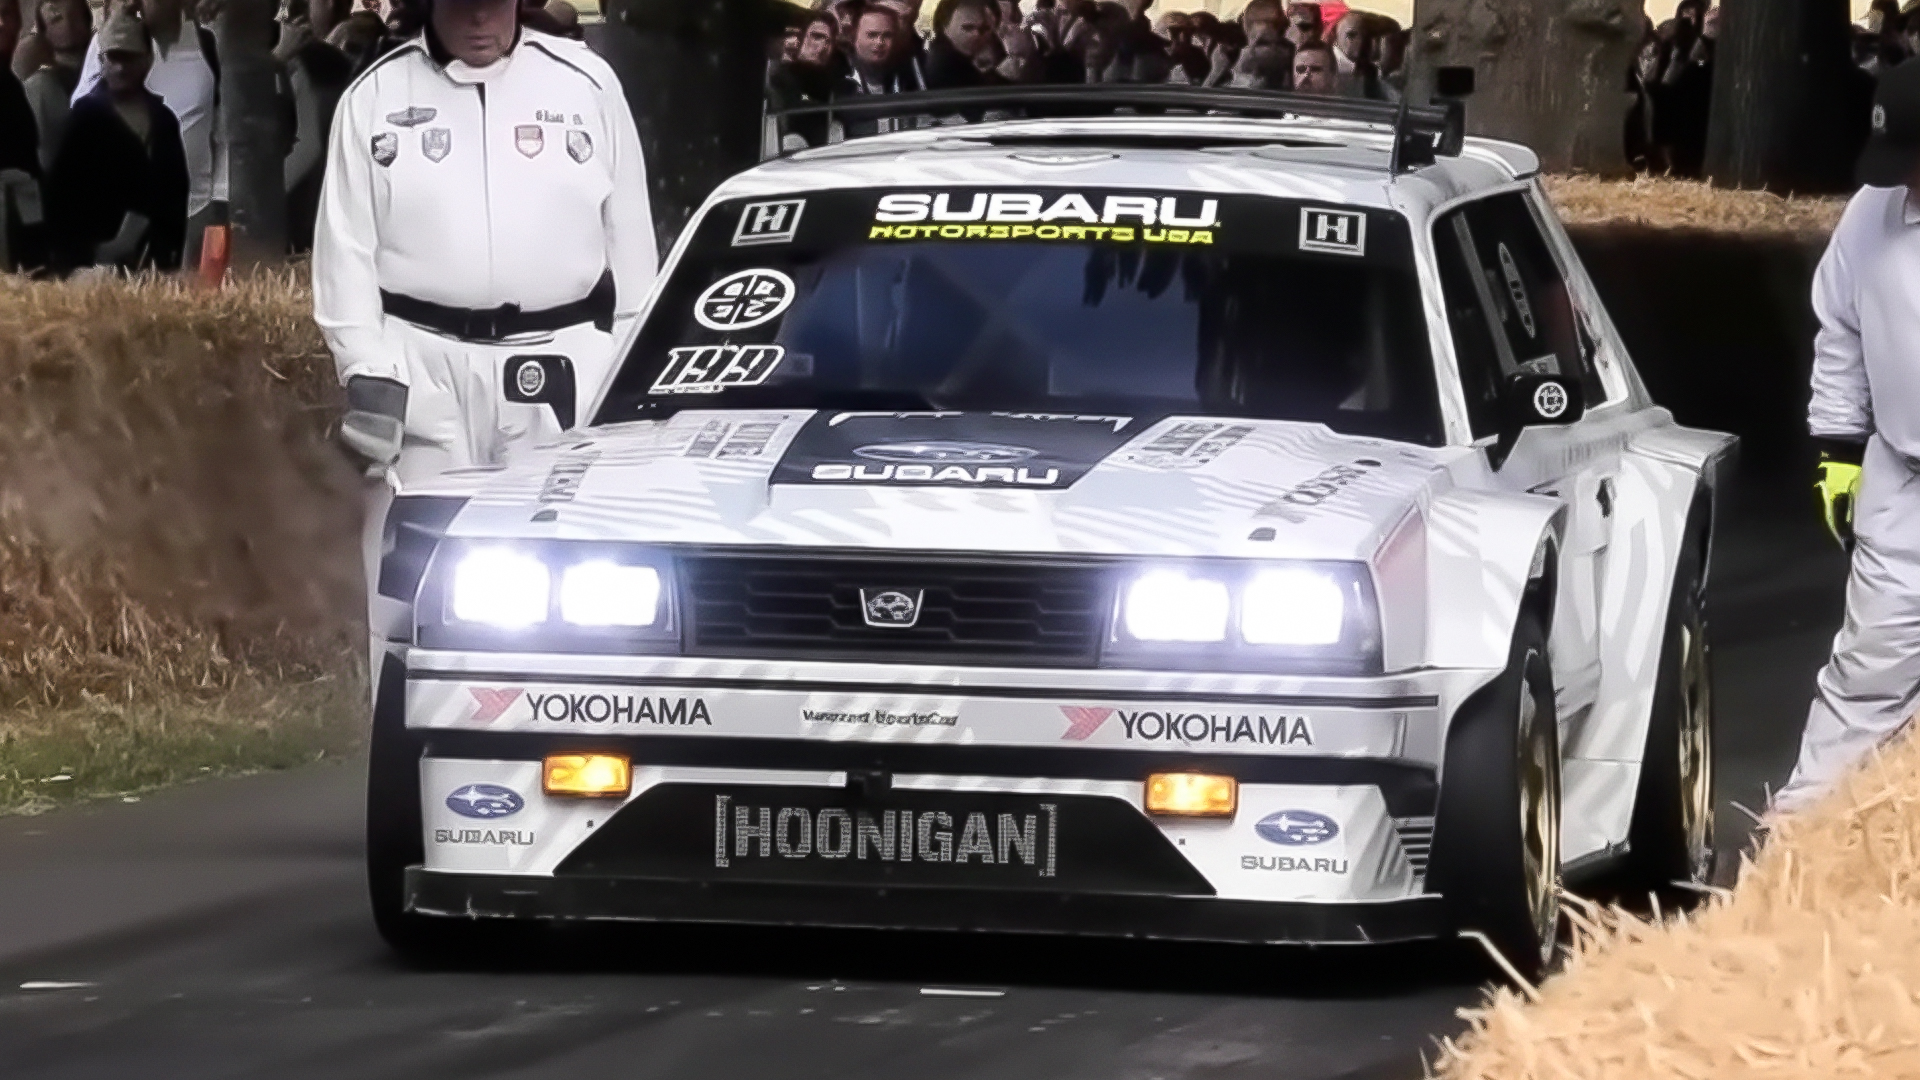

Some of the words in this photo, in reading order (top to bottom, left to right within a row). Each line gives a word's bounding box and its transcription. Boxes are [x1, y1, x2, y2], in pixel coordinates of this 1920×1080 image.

[875, 193, 1219, 227] SUBARU
[869, 225, 1134, 241] MOTORSPORTS
[1143, 228, 1213, 244] USA
[650, 345, 785, 389] 199
[811, 464, 1060, 485] SUBARU
[526, 692, 712, 726] YOKOHAMA
[1117, 709, 1314, 746] YOKOHAMA
[435, 829, 534, 846] SUBARU
[1240, 855, 1349, 875] SUBARU
